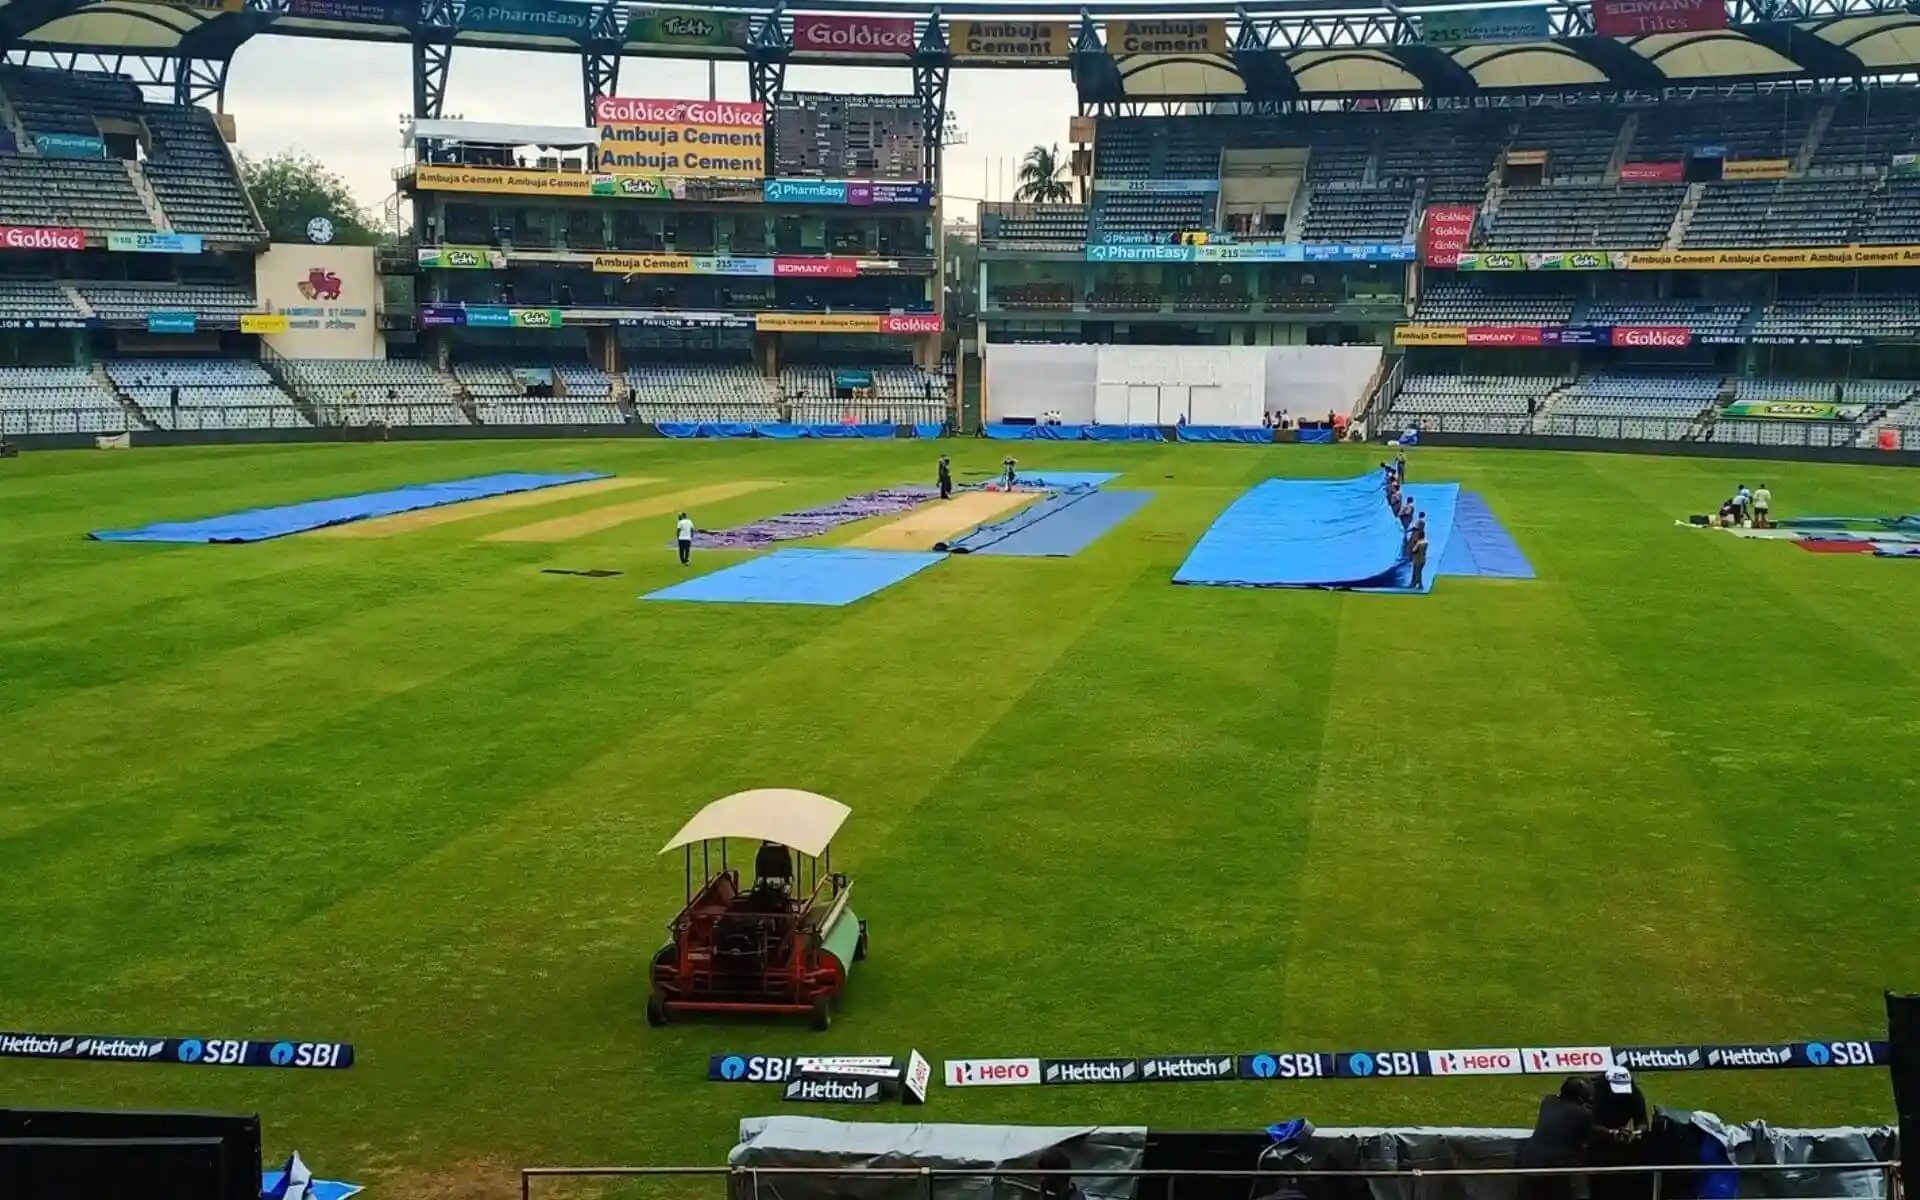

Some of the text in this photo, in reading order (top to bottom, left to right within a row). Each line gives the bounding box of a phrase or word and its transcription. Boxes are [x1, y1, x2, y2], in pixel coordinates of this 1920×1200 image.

[1605, 0, 1701, 15] SOMANY
[488, 6, 587, 27] PharmEasy
[1637, 16, 1688, 31] Tiles
[808, 23, 913, 47] Goldiee
[967, 22, 1050, 39] Ambuja
[1124, 20, 1207, 37] Ambuja
[1429, 30, 1461, 41] 215
[967, 39, 1050, 54] Cement
[1124, 37, 1207, 53] Cement
[599, 102, 763, 125] Goldiee Goldiee
[601, 125, 762, 146] Ambuja Cement
[601, 150, 762, 171] Ambuja Cement
[419, 172, 460, 185] Ambuja
[462, 174, 503, 185] Cement
[508, 176, 549, 188] Ambuja
[550, 177, 589, 188] Cement
[1129, 181, 1145, 190] 215
[784, 184, 845, 199] PharmEasy
[7, 229, 80, 248] Goldiee
[1109, 245, 1189, 260] PharmEasy
[1631, 255, 1670, 265] Ambuja
[1673, 255, 1715, 264] Cement
[1720, 253, 1761, 264] Ambuja
[1763, 254, 1805, 263] Cement
[1810, 253, 1853, 263] Ambuja
[1855, 252, 1899, 261] Cement
[595, 256, 689, 270] Ambuja Cement
[716, 259, 733, 268] 215
[778, 264, 830, 273] SOMANY
[890, 318, 939, 331] Goldiee
[1397, 331, 1466, 342] Ambuja Cement
[1468, 333, 1515, 342] SOMANY
[1626, 330, 1685, 345] Goldiee
[2, 1035, 341, 1067] Hettich Hettich SBI SBI
[1631, 1041, 1874, 1068] Hettich Hettich SBI
[747, 1055, 791, 1081] SBI
[1062, 1052, 1419, 1082] Hettich Hettich SBI SBI
[802, 1081, 862, 1099] Hettich
